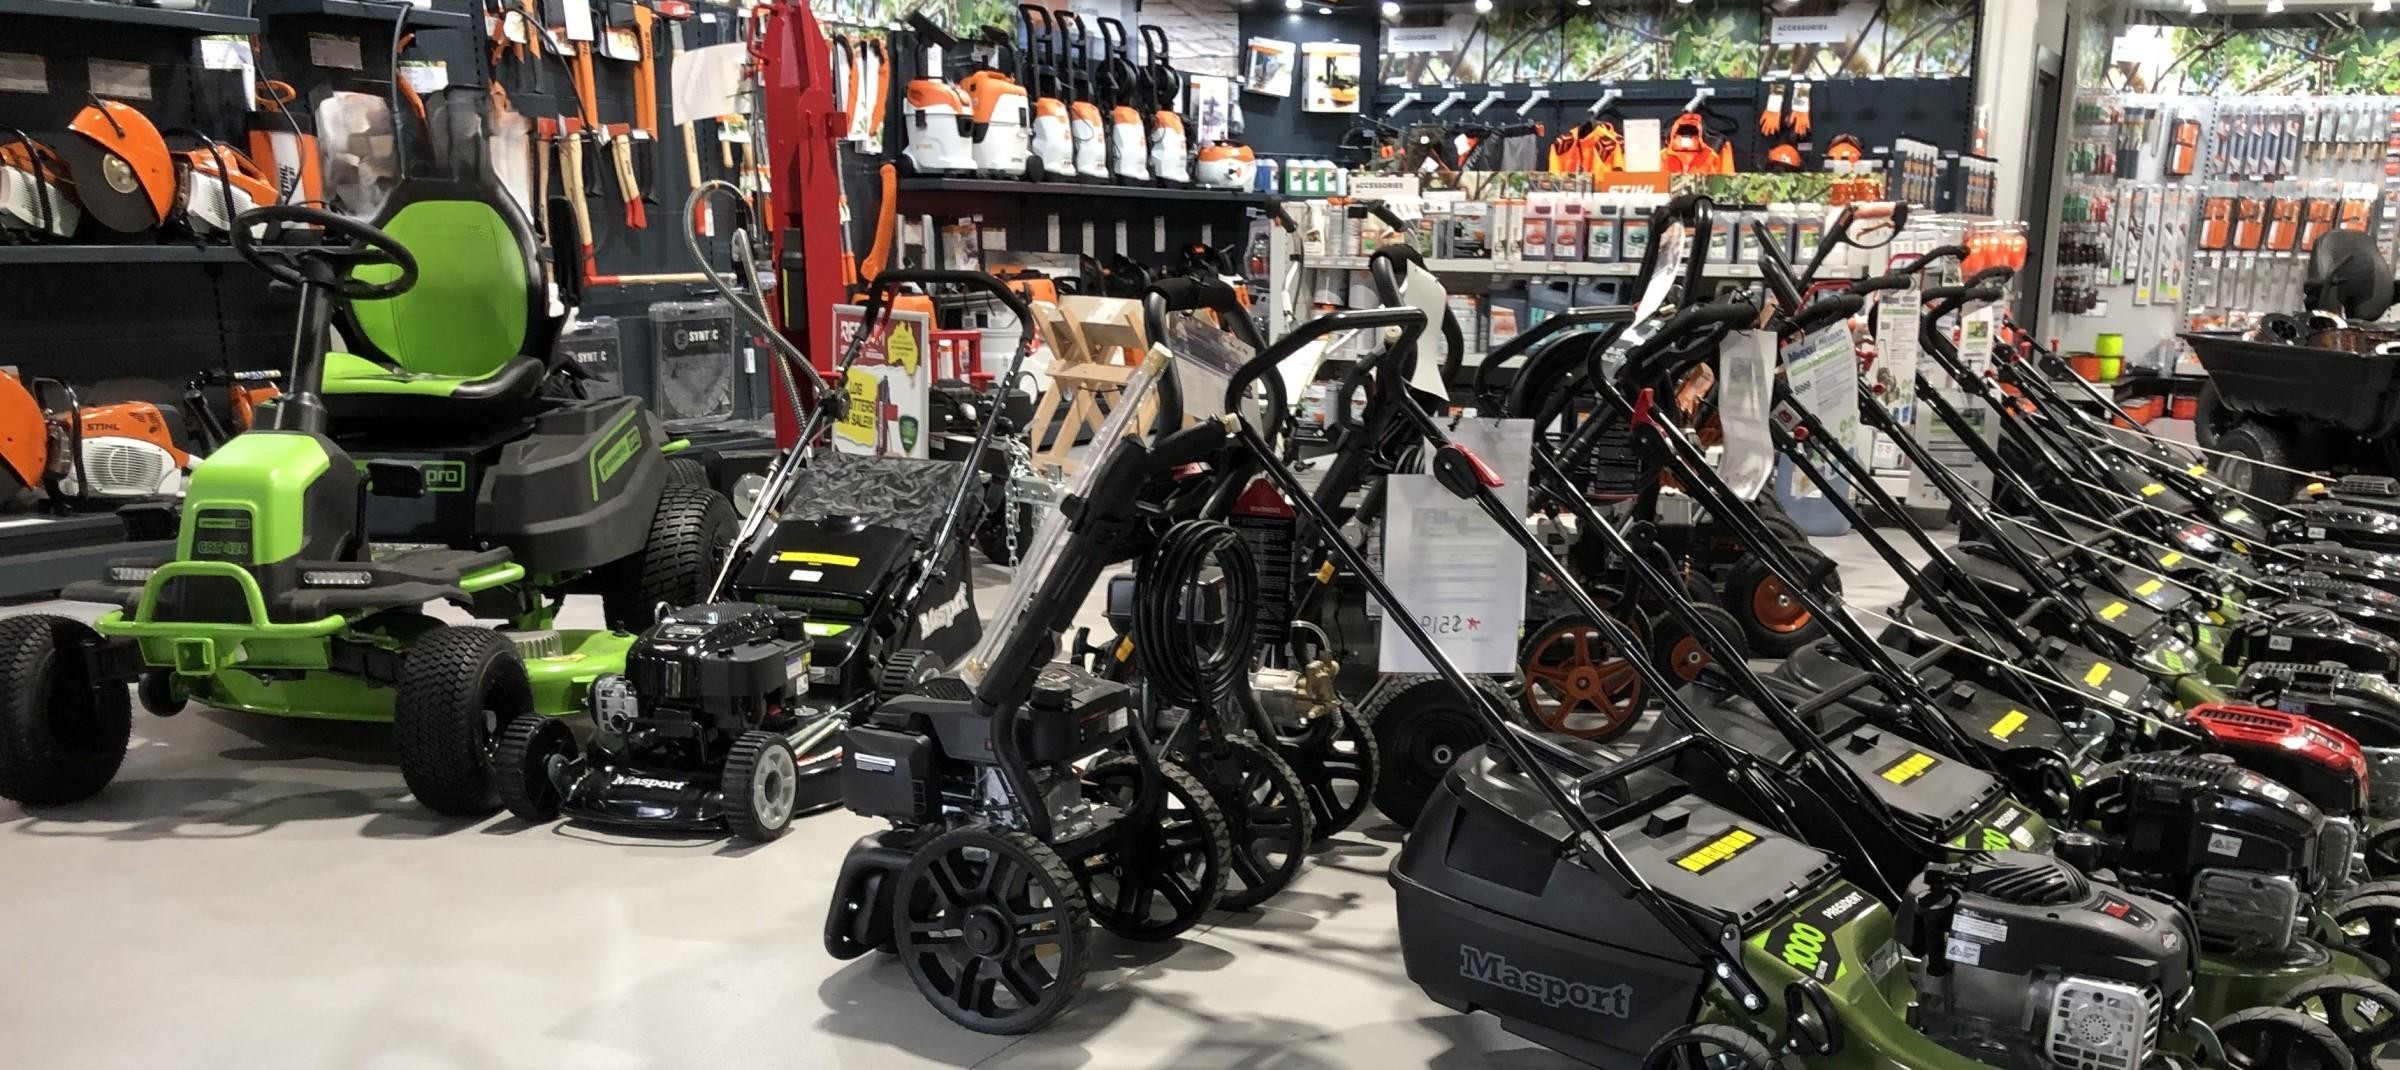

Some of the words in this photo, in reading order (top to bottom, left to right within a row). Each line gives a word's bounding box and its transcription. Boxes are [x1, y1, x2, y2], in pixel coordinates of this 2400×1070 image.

[1778, 24, 1828, 32] ACCESSORIES
[689, 329, 719, 342] SYNTC
[577, 351, 607, 363] SYNTC
[87, 423, 120, 431] STIHL
[425, 470, 458, 486] pro
[611, 773, 685, 790] Masport
[1821, 891, 1864, 920] PRESIDENT
[1782, 922, 1826, 971] 1000
[1460, 944, 1633, 1019] Masport
